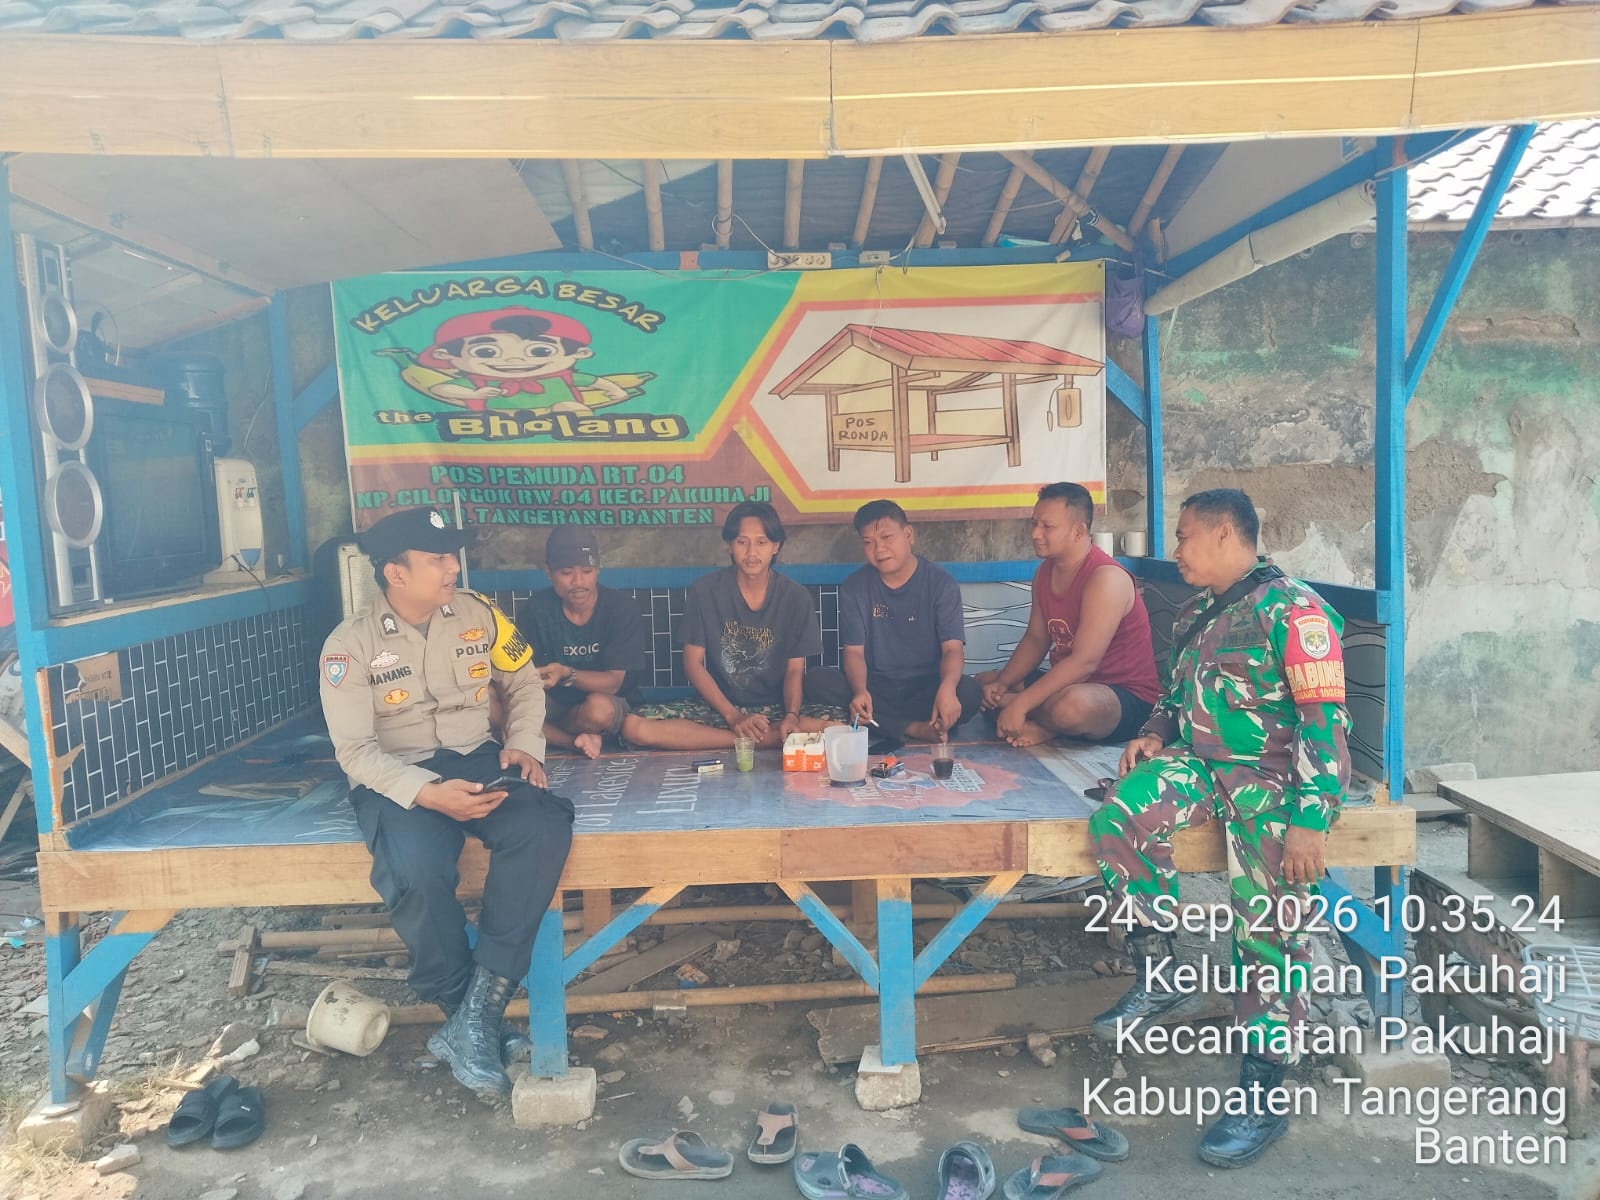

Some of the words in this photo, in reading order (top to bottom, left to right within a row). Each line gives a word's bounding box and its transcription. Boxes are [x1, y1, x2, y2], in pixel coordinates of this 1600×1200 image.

[355, 278, 545, 332] KELUARGA
[557, 283, 661, 331] BESAR
[377, 410, 433, 424] the
[448, 414, 682, 438] Bholang
[845, 416, 876, 429] POS
[838, 429, 888, 442] RONDA
[431, 465, 485, 484] POS
[490, 465, 597, 485] PEMUDA
[602, 465, 685, 484] RT.04
[517, 488, 592, 505] RW.04
[438, 507, 615, 525] A.TANGERANG
[620, 507, 714, 525] BANTEN
[455, 643, 489, 658] POLR
